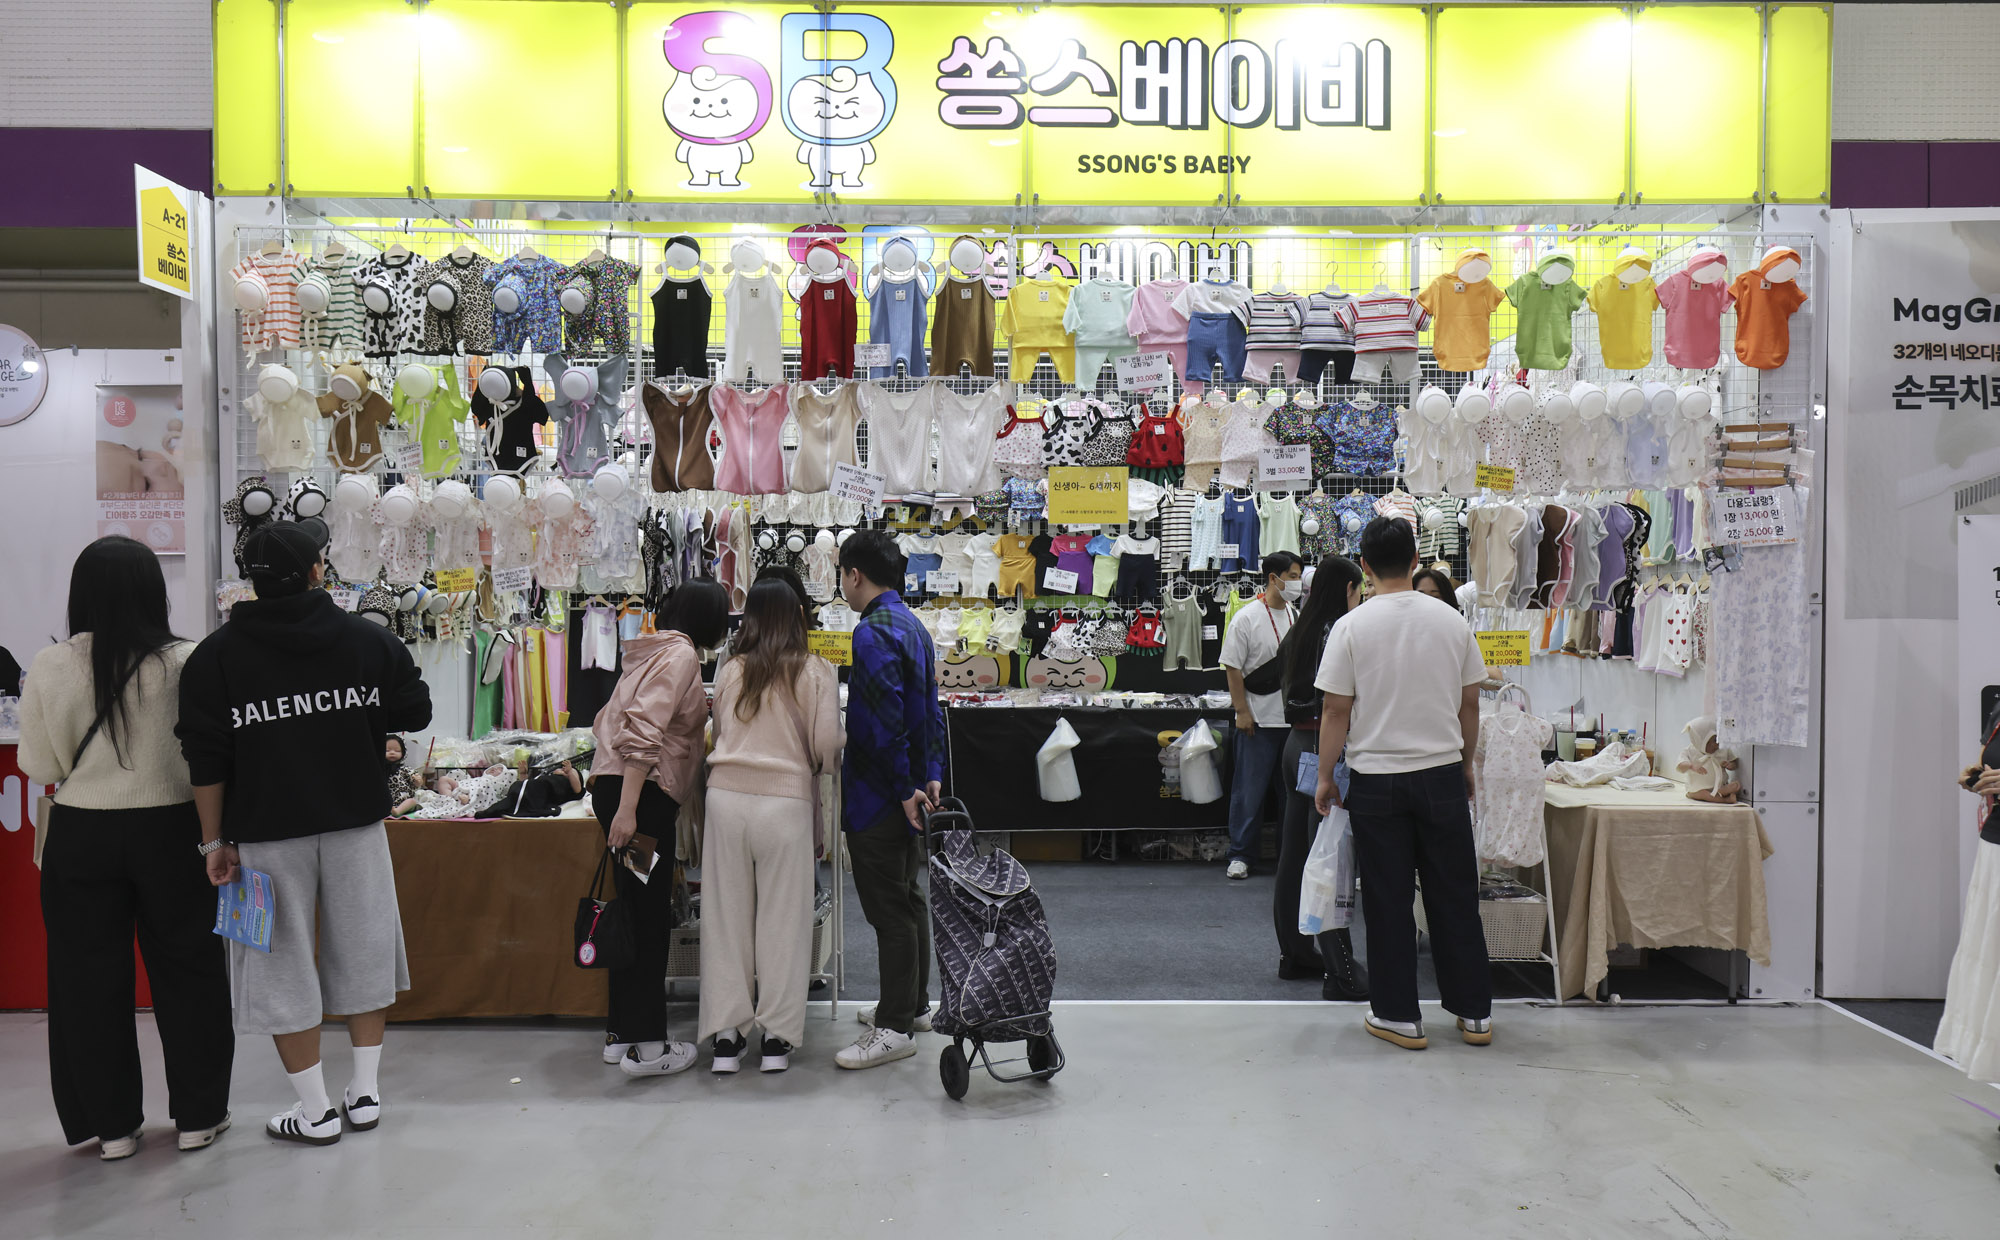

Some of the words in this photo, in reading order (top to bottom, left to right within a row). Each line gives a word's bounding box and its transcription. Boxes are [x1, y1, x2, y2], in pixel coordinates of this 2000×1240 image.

[936, 35, 1391, 131] 쏭스베이비
[1078, 154, 1177, 174] SSONG'S
[1184, 155, 1251, 174] BABY
[163, 208, 186, 231] A-21
[167, 242, 186, 263] 쏭스
[158, 257, 187, 282] 베이비
[1893, 343, 1947, 361] 32개의
[1136, 373, 1163, 383] 33,000원
[1278, 465, 1305, 474] 33,000원
[849, 484, 876, 498] 20,000원
[1724, 512, 1736, 523] 1장
[1740, 510, 1769, 520] 13,000
[1727, 529, 1741, 540] 2장
[1743, 527, 1773, 537] 25,000
[1774, 525, 1784, 536] 원
[1495, 649, 1523, 657] 20,000원
[1495, 658, 1523, 666] 37,000원
[231, 685, 381, 729] BALENCIAA
